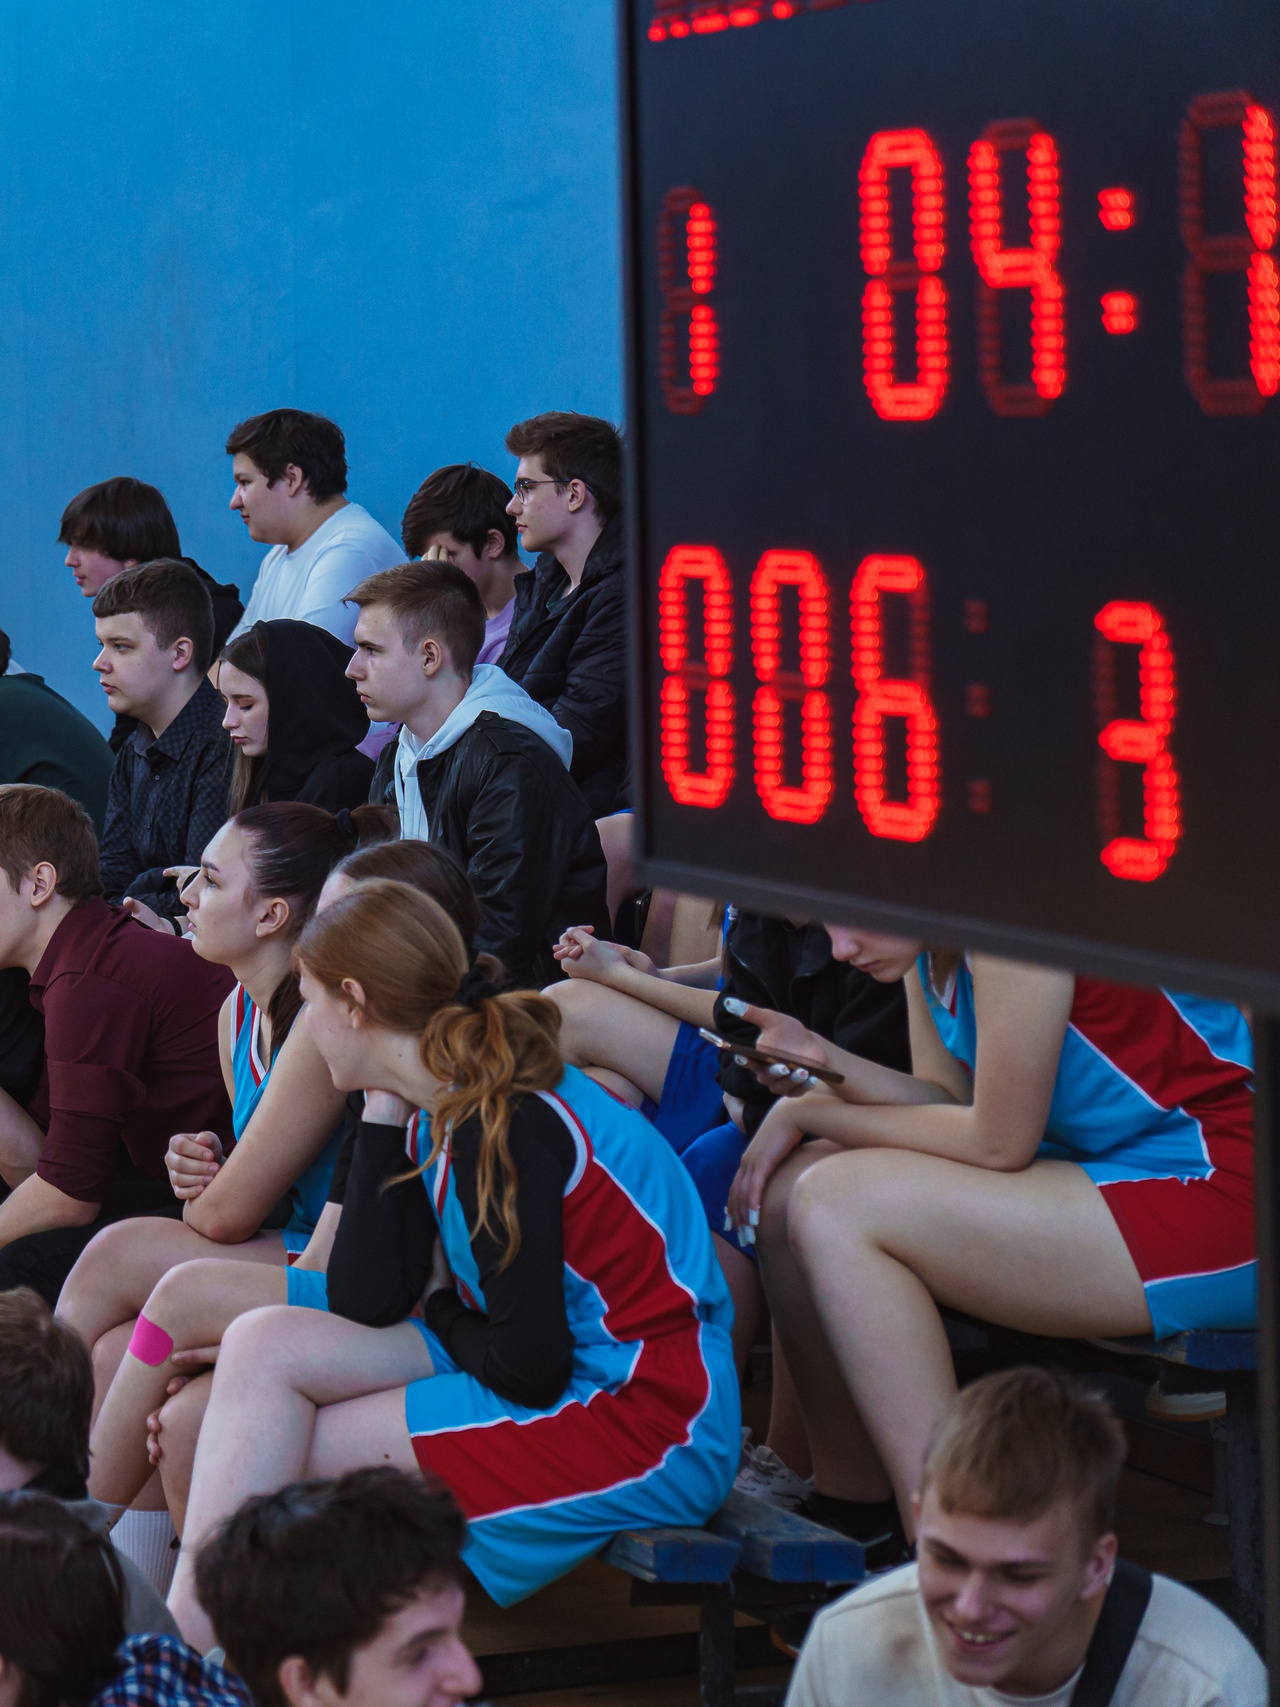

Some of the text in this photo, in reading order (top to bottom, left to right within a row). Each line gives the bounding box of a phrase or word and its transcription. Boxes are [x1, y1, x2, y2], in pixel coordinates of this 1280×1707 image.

[686, 201, 718, 397] 1
[658, 544, 941, 843] 006
[1094, 600, 1184, 883] 3
